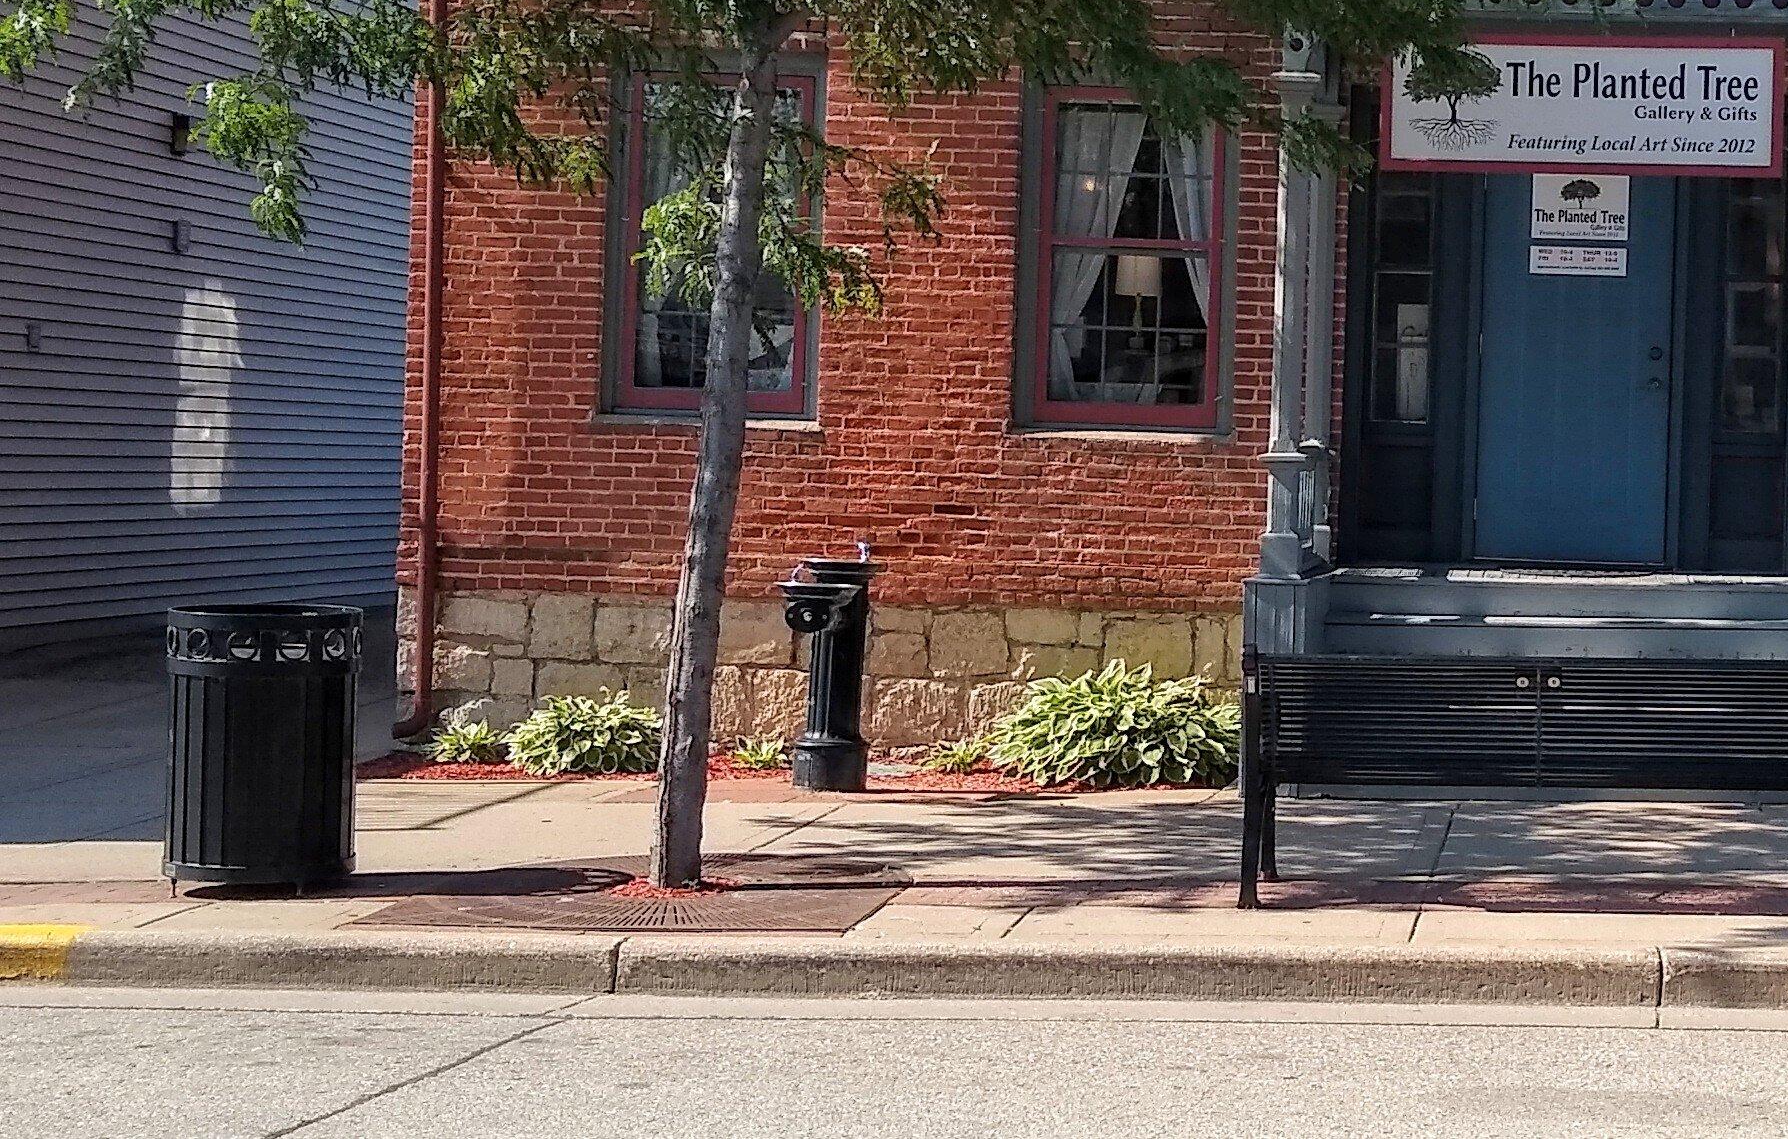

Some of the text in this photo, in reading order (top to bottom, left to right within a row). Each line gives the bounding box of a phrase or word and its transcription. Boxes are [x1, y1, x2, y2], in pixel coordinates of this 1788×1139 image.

[1506, 60, 1759, 101] The Planted Tree
[1634, 105, 1758, 124] Gallery & Gifts
[1507, 134, 1756, 155] Featuring Local Art Since 2012
[1534, 209, 1625, 224] The Planted Tree
